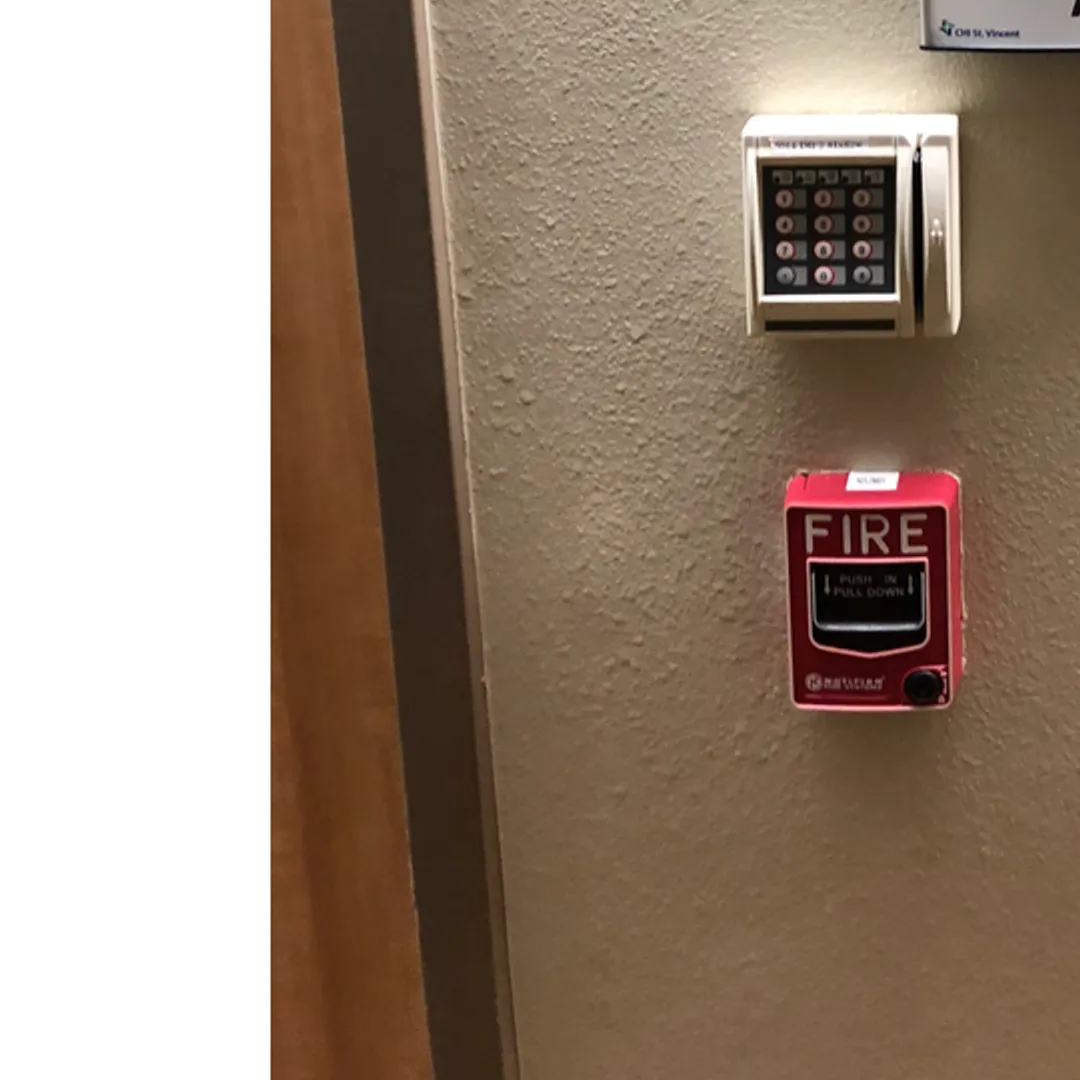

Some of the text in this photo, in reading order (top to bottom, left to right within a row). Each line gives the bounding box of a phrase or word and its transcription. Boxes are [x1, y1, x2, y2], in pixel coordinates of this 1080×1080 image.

[973, 28, 984, 37] St.
[985, 28, 1020, 38] Vincent
[804, 513, 929, 555] FIRE
[840, 574, 897, 585] PUSH IN
[833, 586, 904, 598] PULL DOWN
